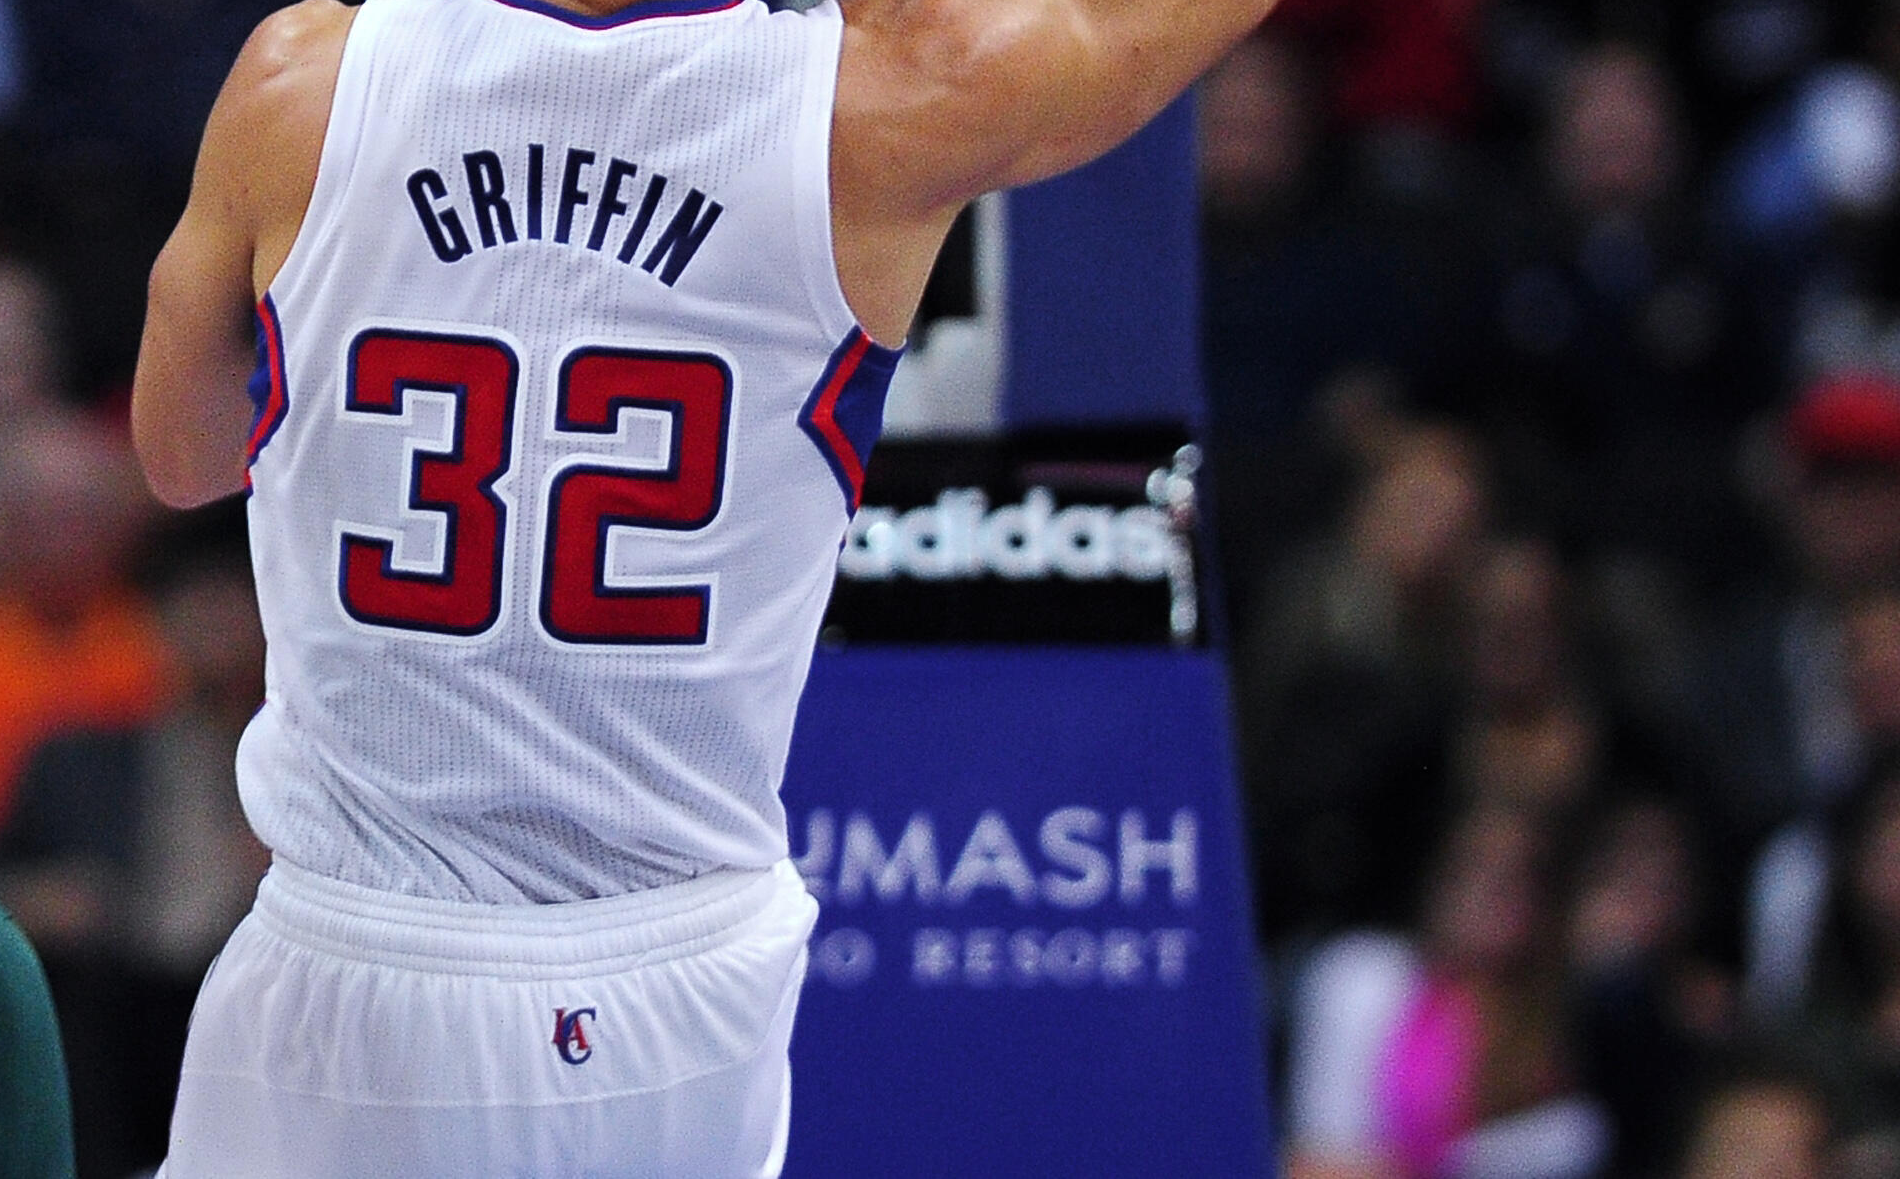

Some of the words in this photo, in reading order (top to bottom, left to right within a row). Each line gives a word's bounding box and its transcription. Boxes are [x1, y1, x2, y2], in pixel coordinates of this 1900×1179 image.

[406, 142, 724, 288] GRIFFIN
[335, 321, 740, 651] 32
[838, 487, 1180, 579] adidas
[911, 928, 1192, 987] RESORT
